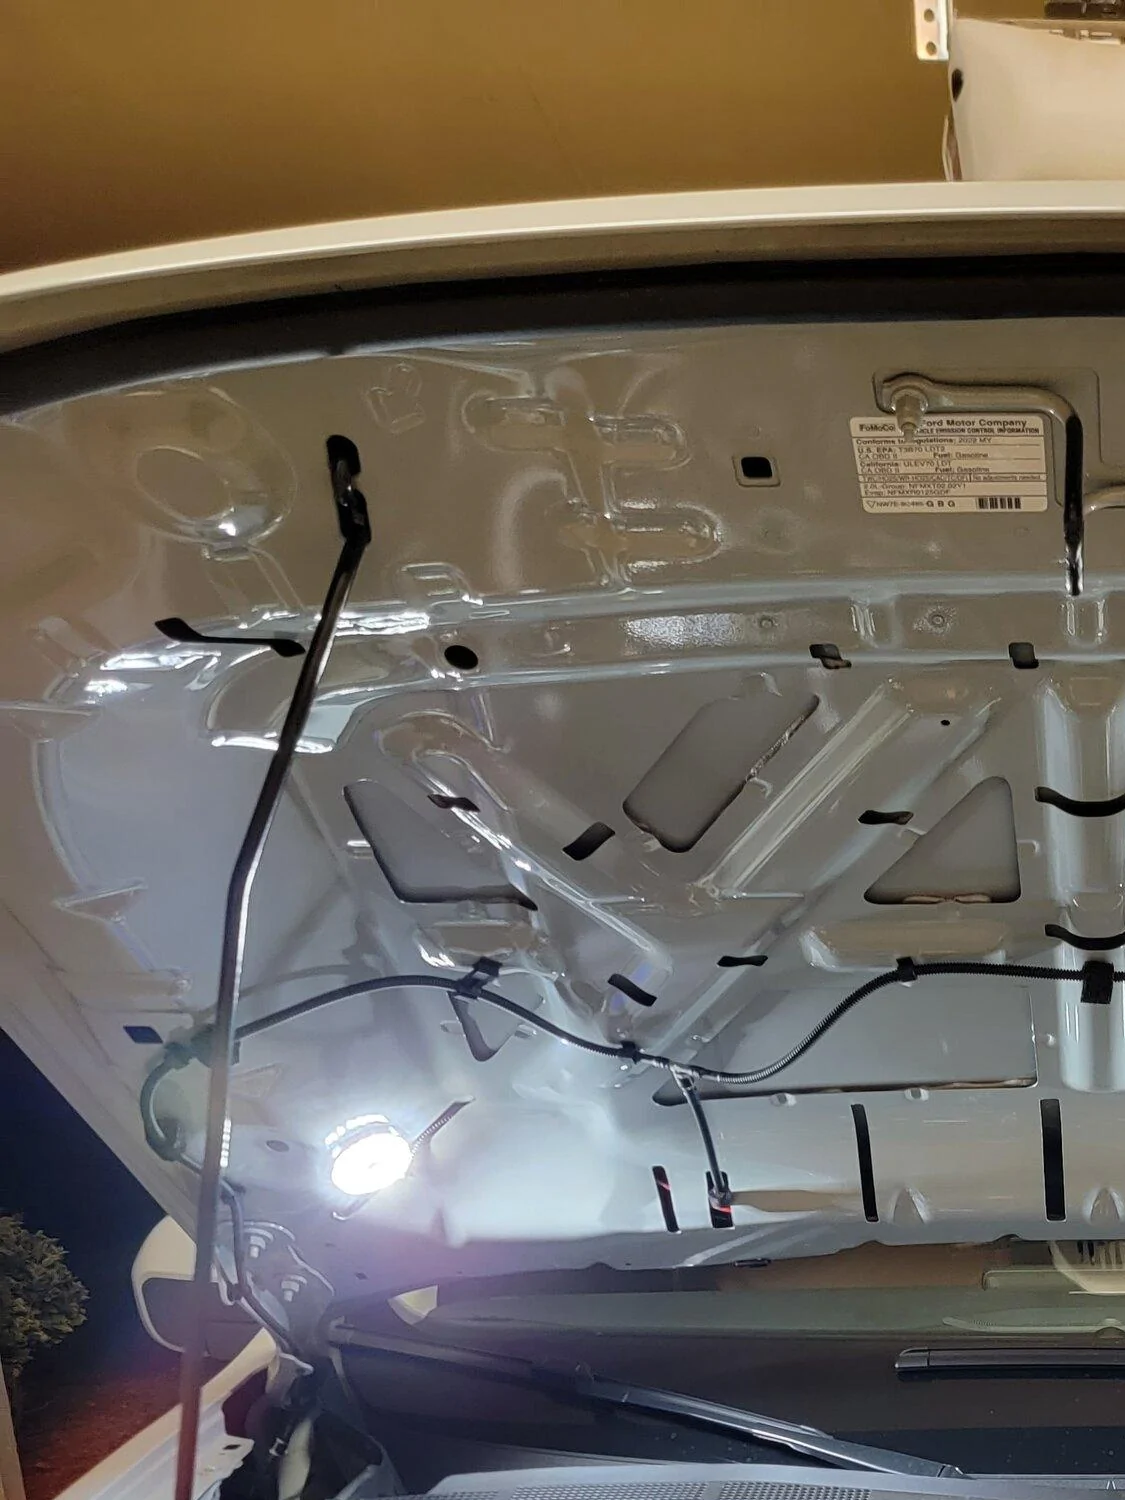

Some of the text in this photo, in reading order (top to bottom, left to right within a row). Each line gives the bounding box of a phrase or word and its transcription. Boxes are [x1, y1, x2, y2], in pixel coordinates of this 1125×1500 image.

[859, 423, 896, 432] FoMoCo
[946, 419, 976, 427] Motor
[978, 419, 1028, 430] Company
